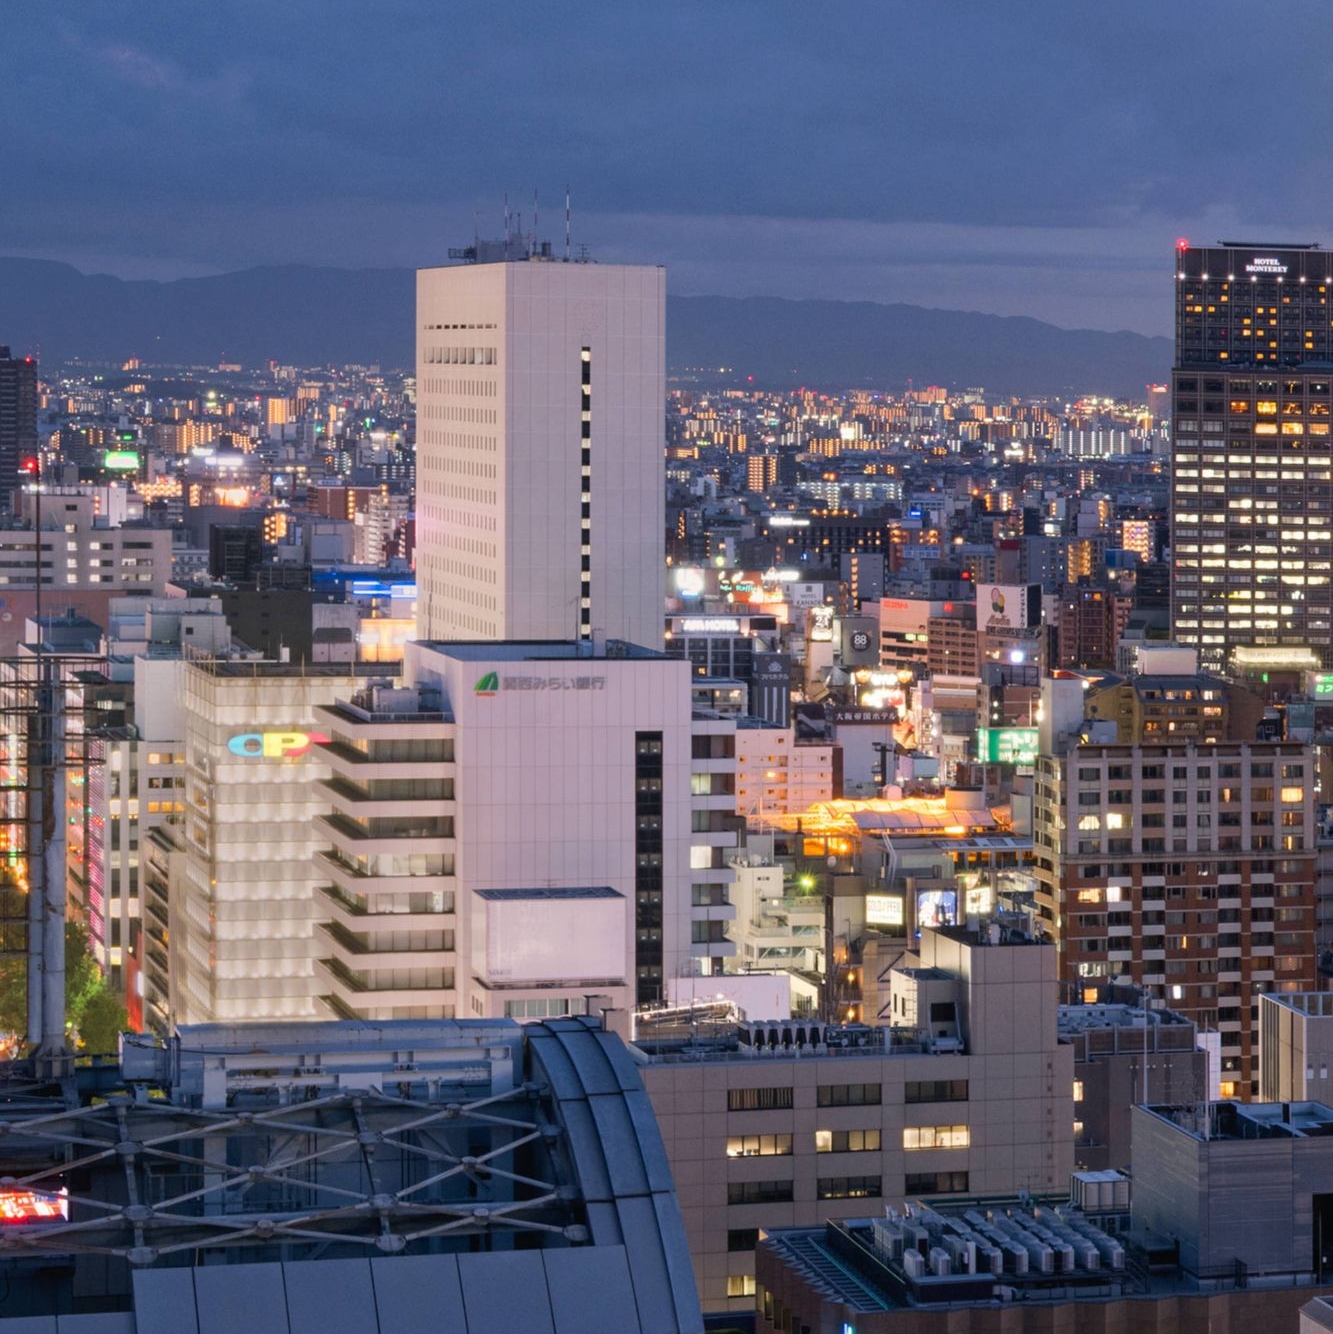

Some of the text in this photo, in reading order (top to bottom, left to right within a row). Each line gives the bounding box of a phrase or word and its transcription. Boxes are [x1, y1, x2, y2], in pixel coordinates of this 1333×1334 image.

[1254, 258, 1280, 266] HOTEL
[1245, 265, 1288, 273] MONTEREY
[705, 620, 739, 631] HOTEL
[854, 634, 867, 645] 88
[999, 730, 1039, 750] ニトリ
